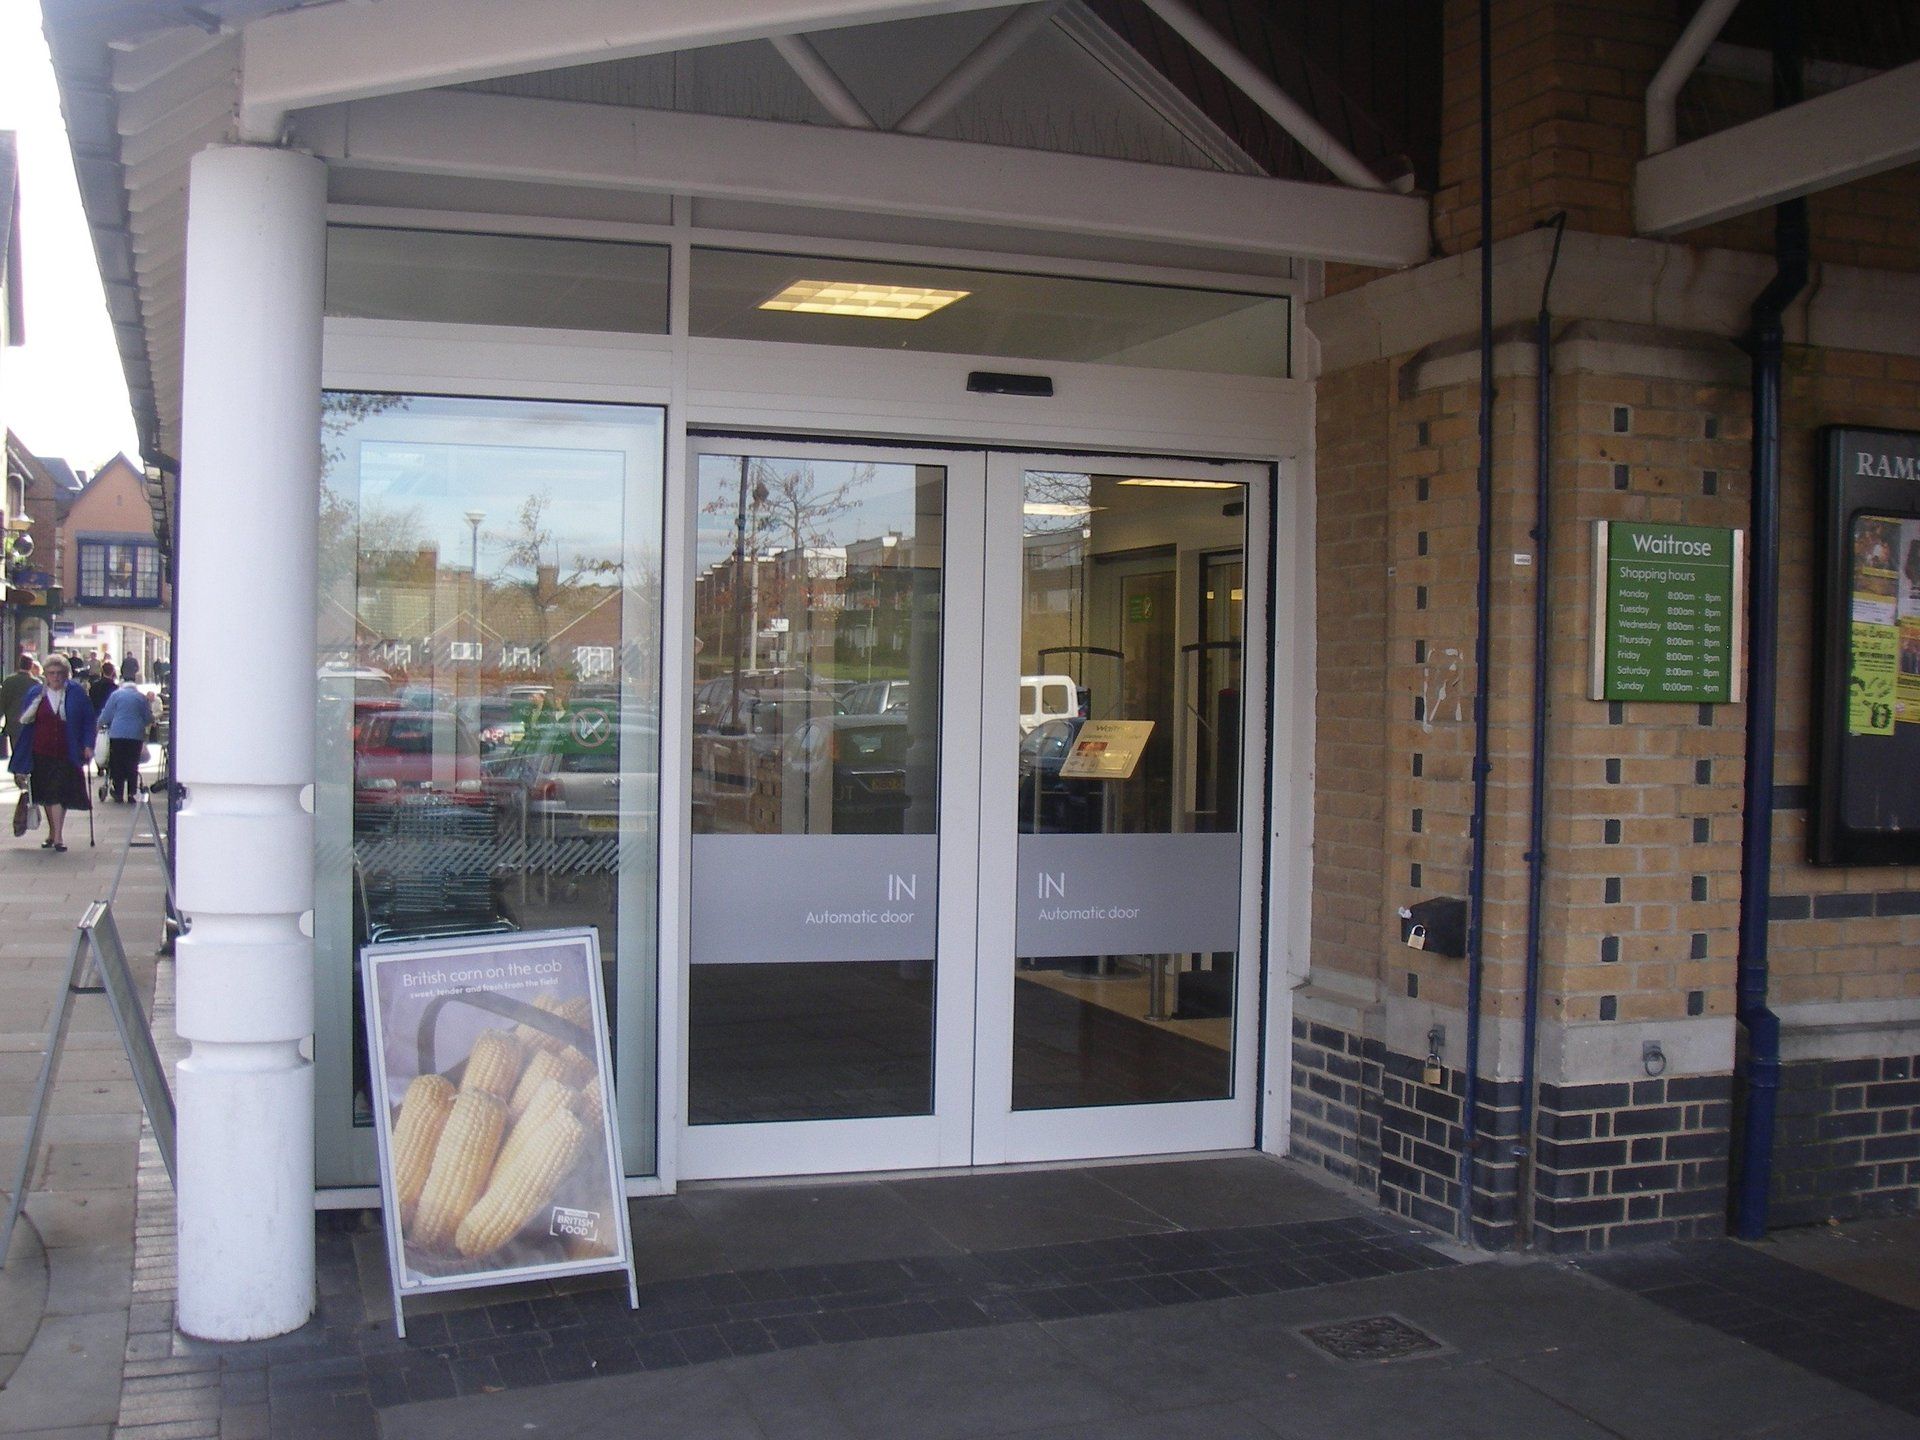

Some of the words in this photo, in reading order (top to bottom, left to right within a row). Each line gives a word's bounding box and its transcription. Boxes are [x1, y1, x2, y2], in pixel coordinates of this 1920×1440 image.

[1856, 452, 1920, 481] RAM
[1632, 533, 1712, 556] Waitrose
[1620, 566, 1666, 583] Shopping
[1668, 569, 1696, 581] hours
[1619, 589, 1649, 601] Monday
[1704, 593, 1721, 603] 8pm
[1619, 604, 1650, 616] Tuesday
[1704, 609, 1721, 619] 8pm
[1618, 620, 1662, 631] Wednesday
[1704, 624, 1720, 634] 8pm
[1618, 635, 1652, 647] Thursday
[1703, 639, 1720, 649] 8pm
[1617, 650, 1641, 662] Friday
[1617, 665, 1650, 677] Saturday
[1703, 669, 1719, 679] 8pm
[1616, 681, 1645, 693] Sunday
[1703, 684, 1719, 694] 4pm
[888, 874, 916, 900] IN
[1038, 872, 1065, 899] IN
[805, 910, 878, 924] Automatic
[880, 909, 915, 924] door
[1038, 907, 1106, 921] Automatic
[1108, 906, 1140, 920] door
[403, 969, 447, 987] British
[449, 968, 484, 982] corn
[486, 966, 505, 980] on
[508, 963, 531, 977] the
[534, 959, 562, 974] cob
[465, 985, 482, 993] and
[525, 979, 539, 987] the
[557, 1214, 594, 1229] BRITISH
[560, 1224, 588, 1236] FOOD
